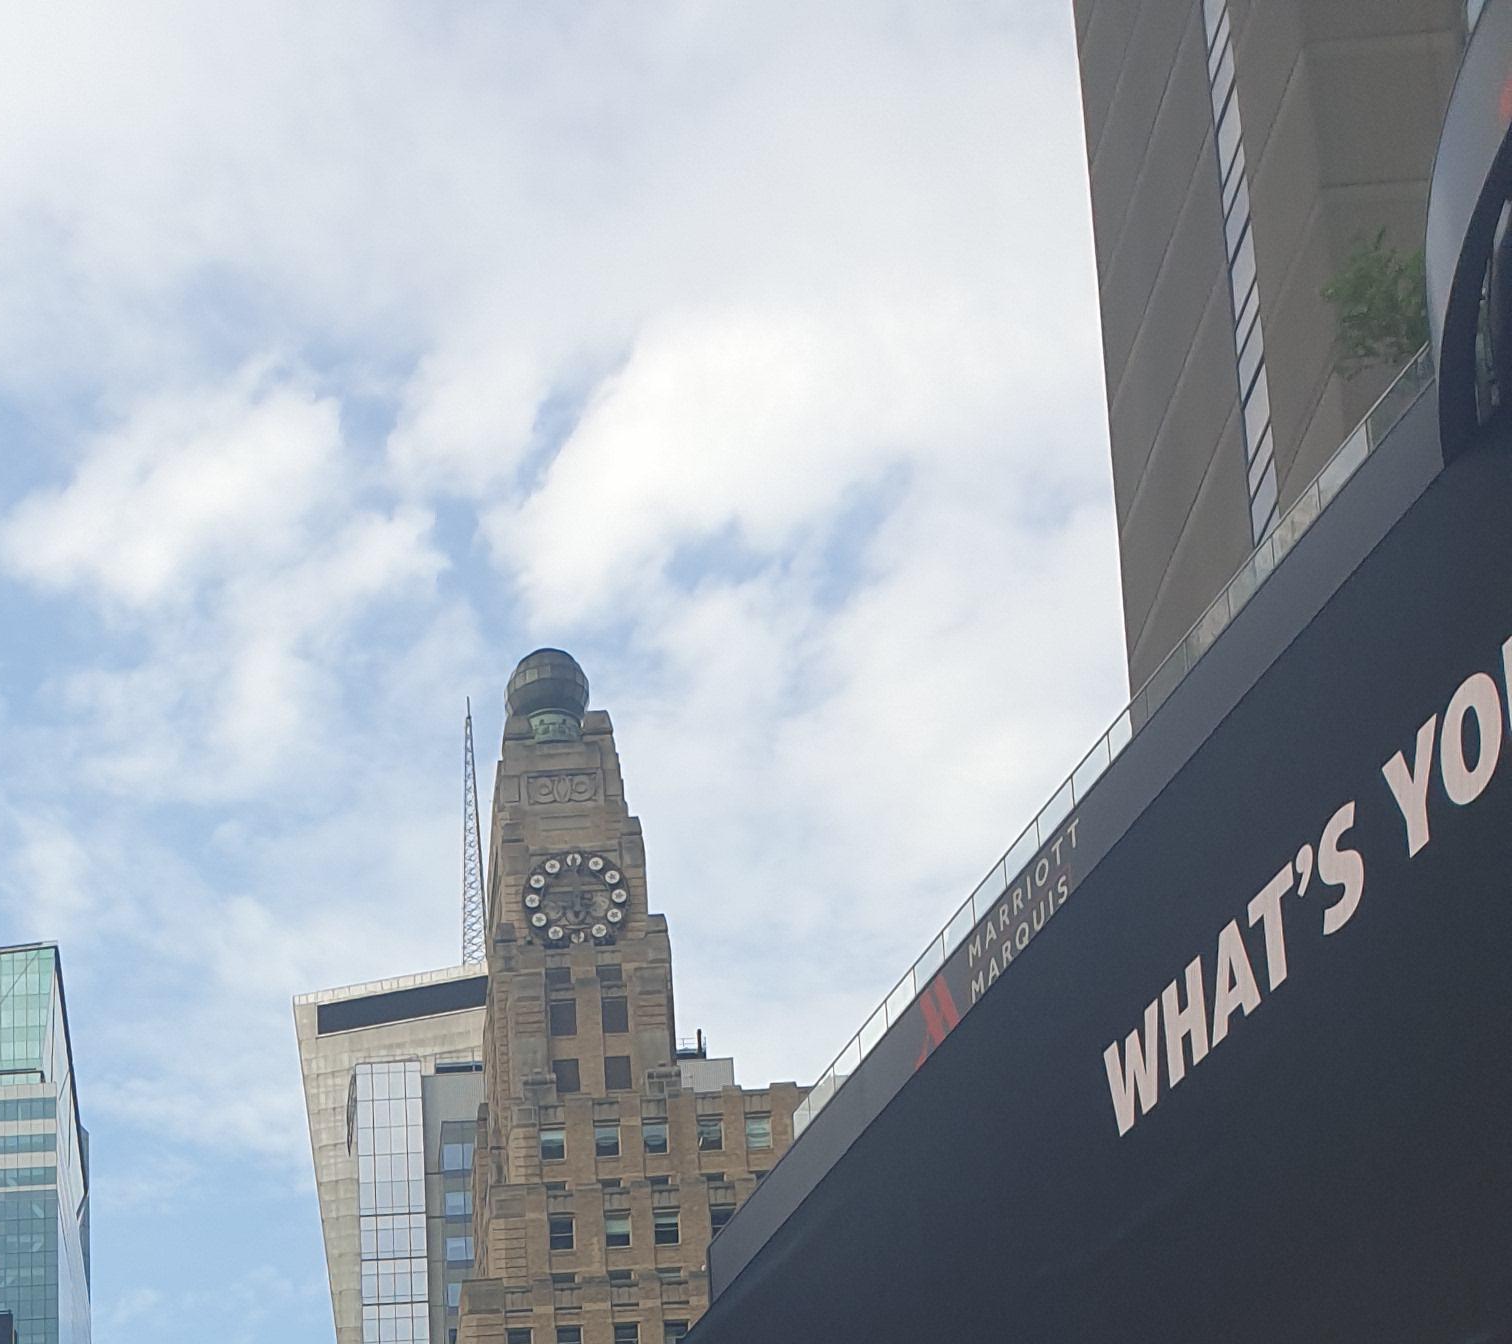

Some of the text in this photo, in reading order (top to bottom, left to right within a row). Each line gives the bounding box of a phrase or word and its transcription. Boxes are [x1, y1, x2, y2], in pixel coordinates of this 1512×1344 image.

[968, 818, 1079, 968] MARRIOTT
[970, 875, 1069, 1004] MARQUIS
[1103, 800, 1365, 1137] WHAT'S
